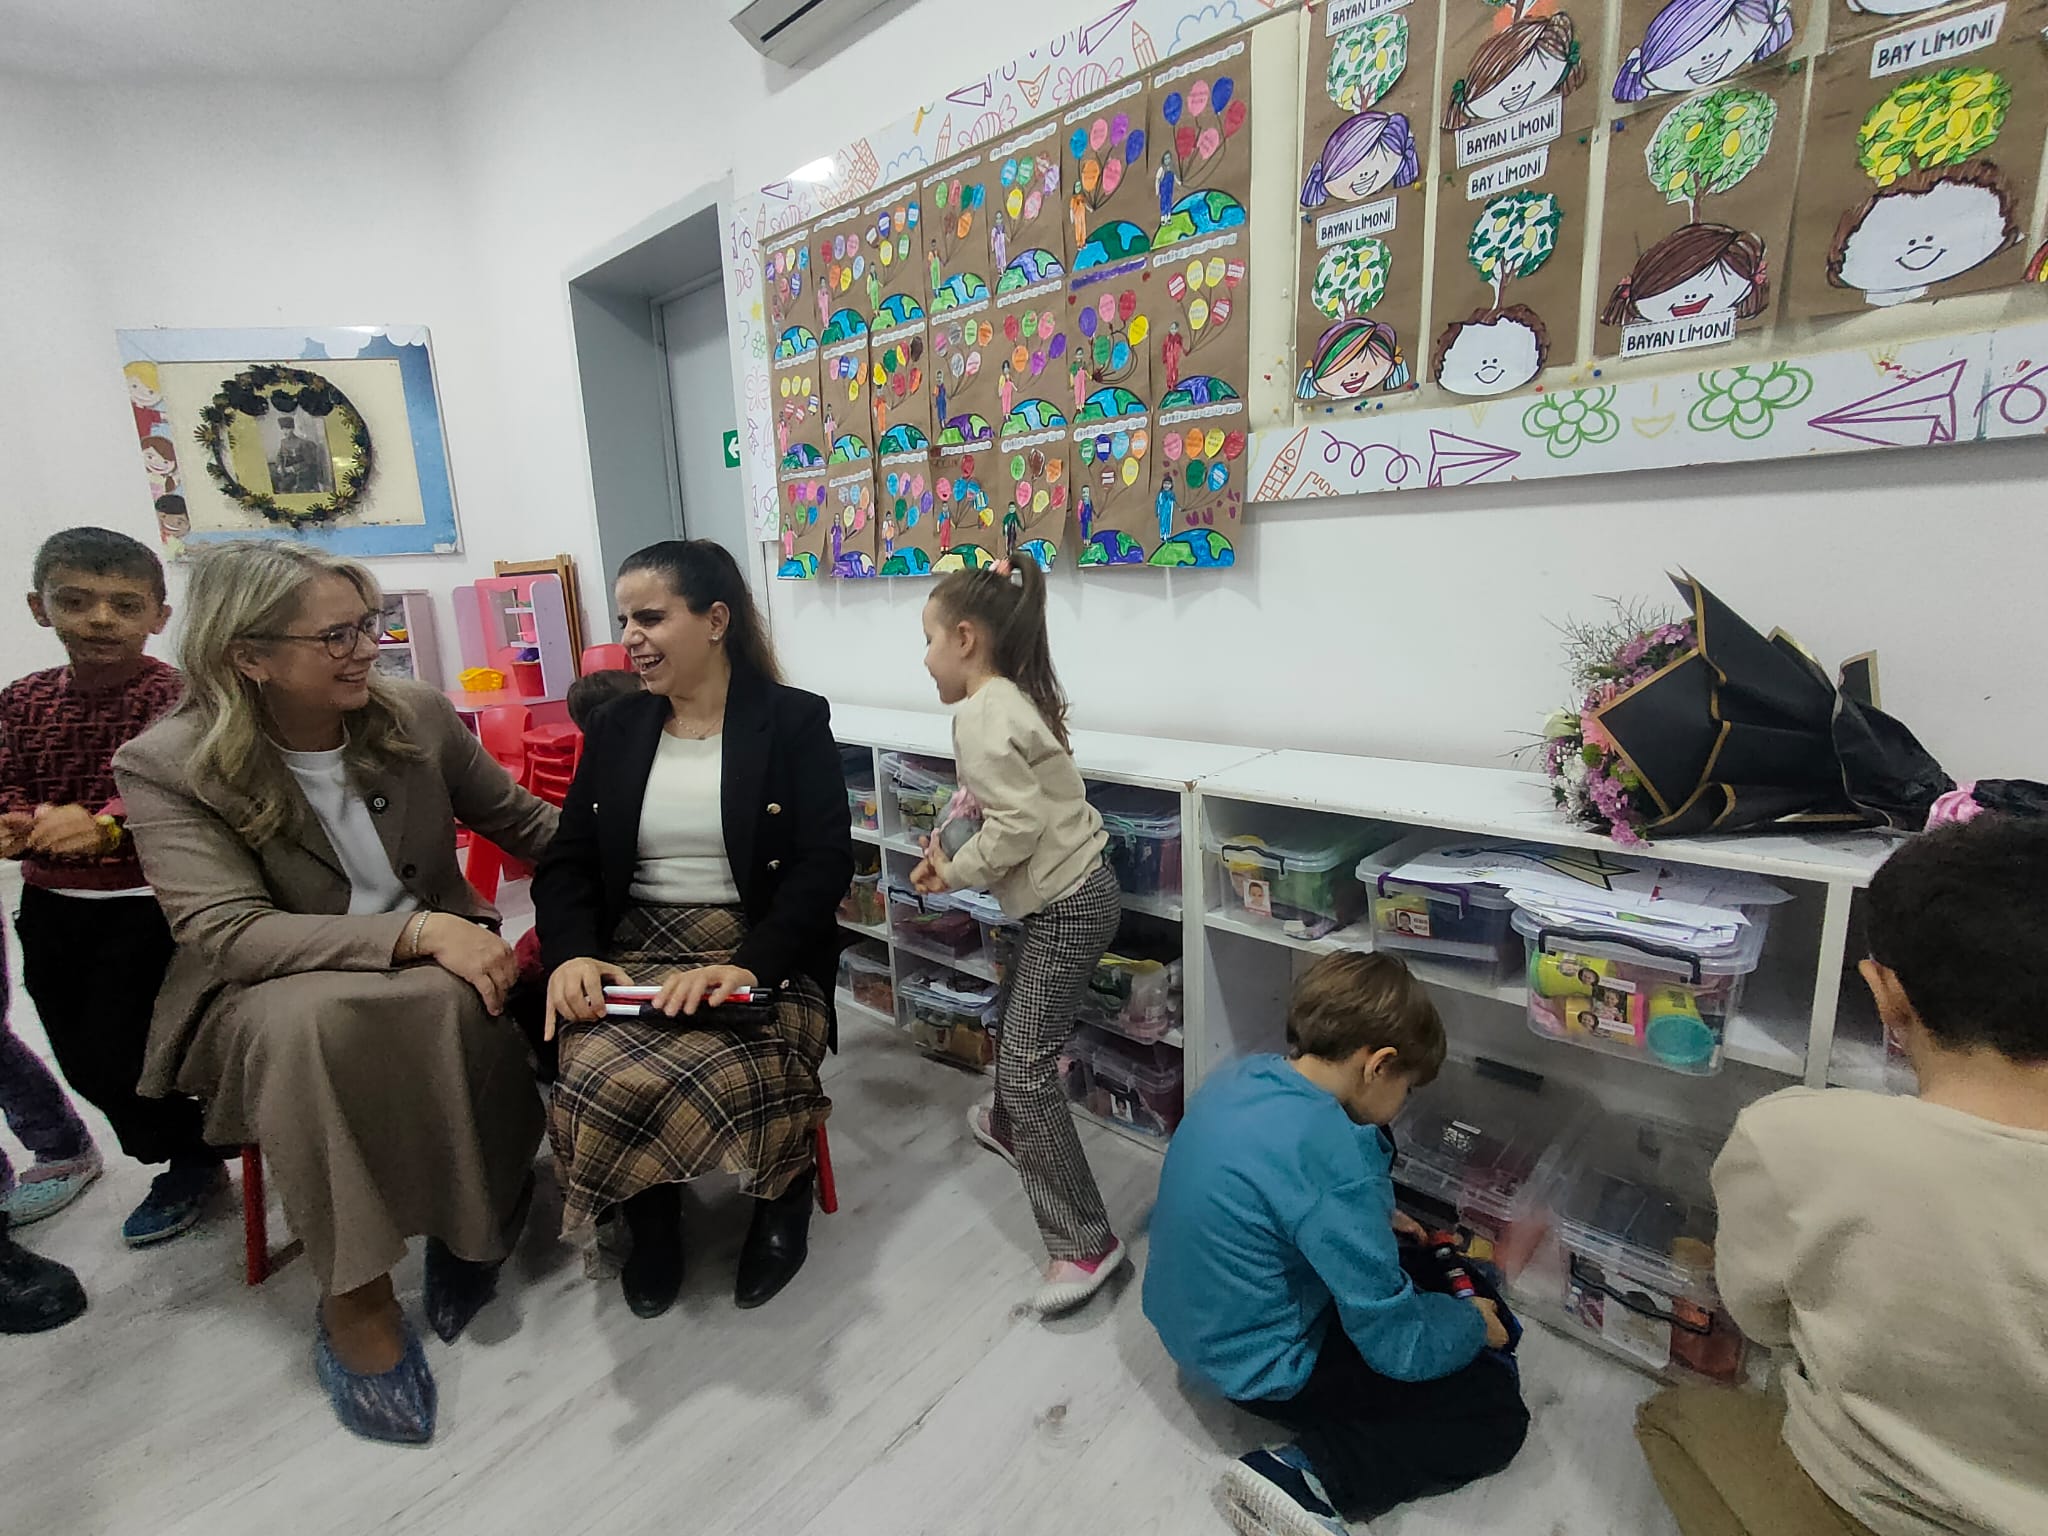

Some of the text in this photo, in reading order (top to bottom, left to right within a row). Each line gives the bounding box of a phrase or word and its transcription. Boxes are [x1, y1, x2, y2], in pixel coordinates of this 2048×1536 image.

[1332, 0, 1366, 25] BAYAN
[1877, 14, 1995, 68] BAY LİMONİ
[1467, 109, 1554, 155] BAYAN LİMONİ
[1471, 156, 1541, 193] BAY LİMONİ
[1321, 206, 1391, 240] BAYAN LİMONİ
[1627, 317, 1731, 351] BAYAN LİMONİ
